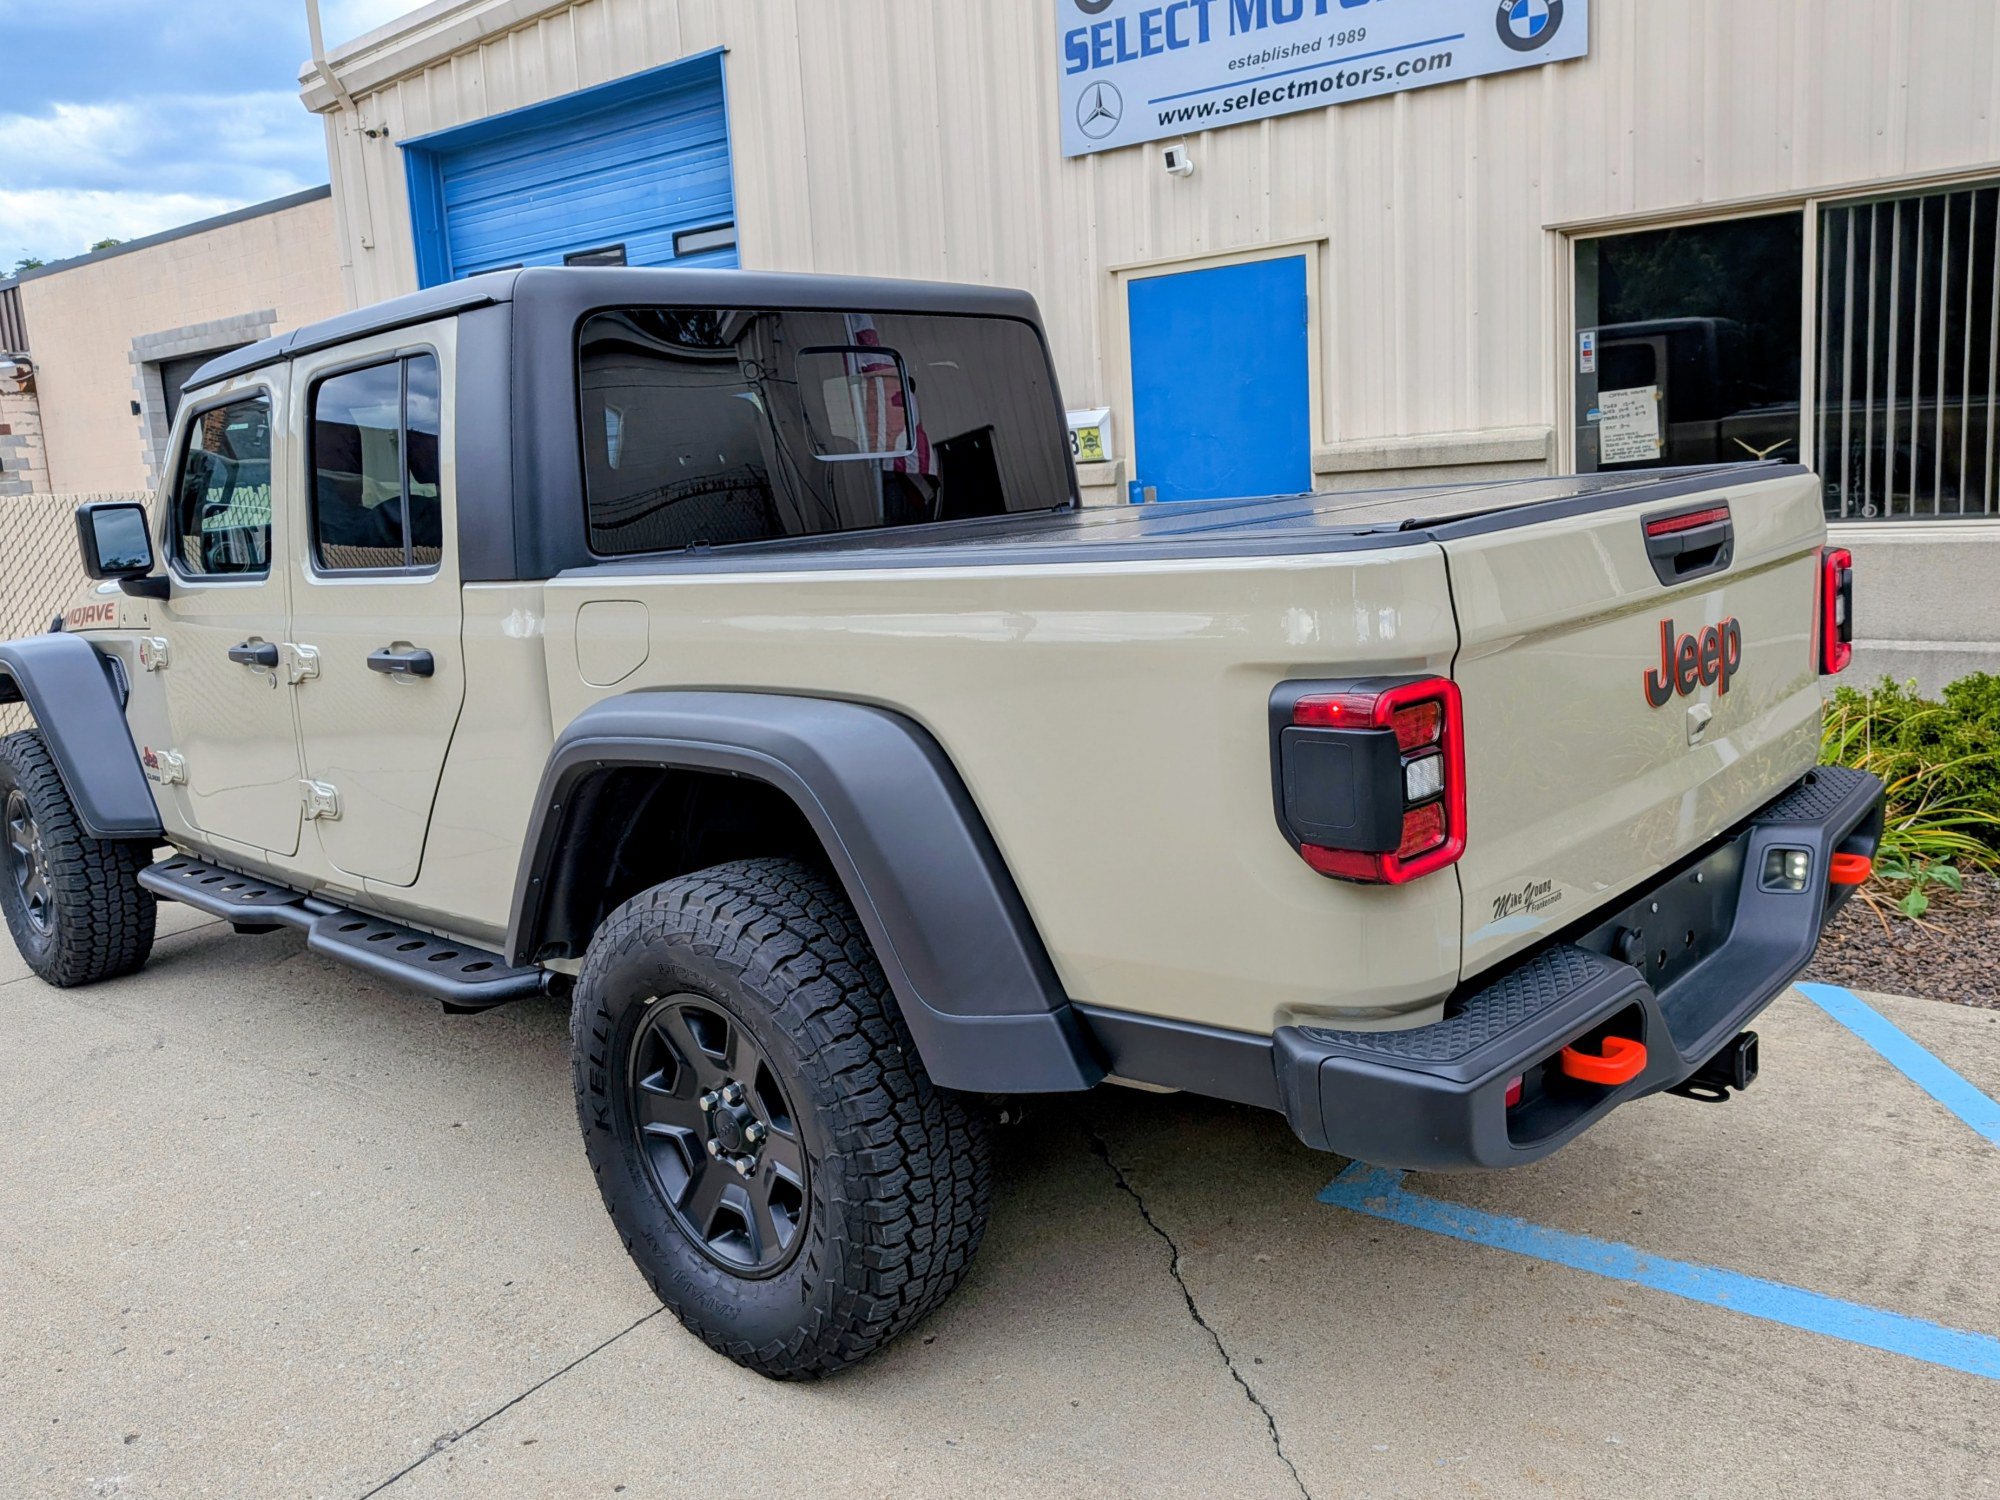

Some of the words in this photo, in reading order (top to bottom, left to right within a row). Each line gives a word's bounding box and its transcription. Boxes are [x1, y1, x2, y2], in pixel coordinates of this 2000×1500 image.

[1065, 0, 1217, 75] SELECT
[1227, 37, 1321, 70] established
[1327, 27, 1367, 48] 1989
[1157, 51, 1453, 126] www.selectmotors.com
[64, 602, 115, 627] MOJAVE
[1643, 614, 1742, 709] Jeep
[1492, 892, 1523, 919] Mike
[1523, 879, 1552, 913] Young
[590, 997, 614, 1135] KELLY
